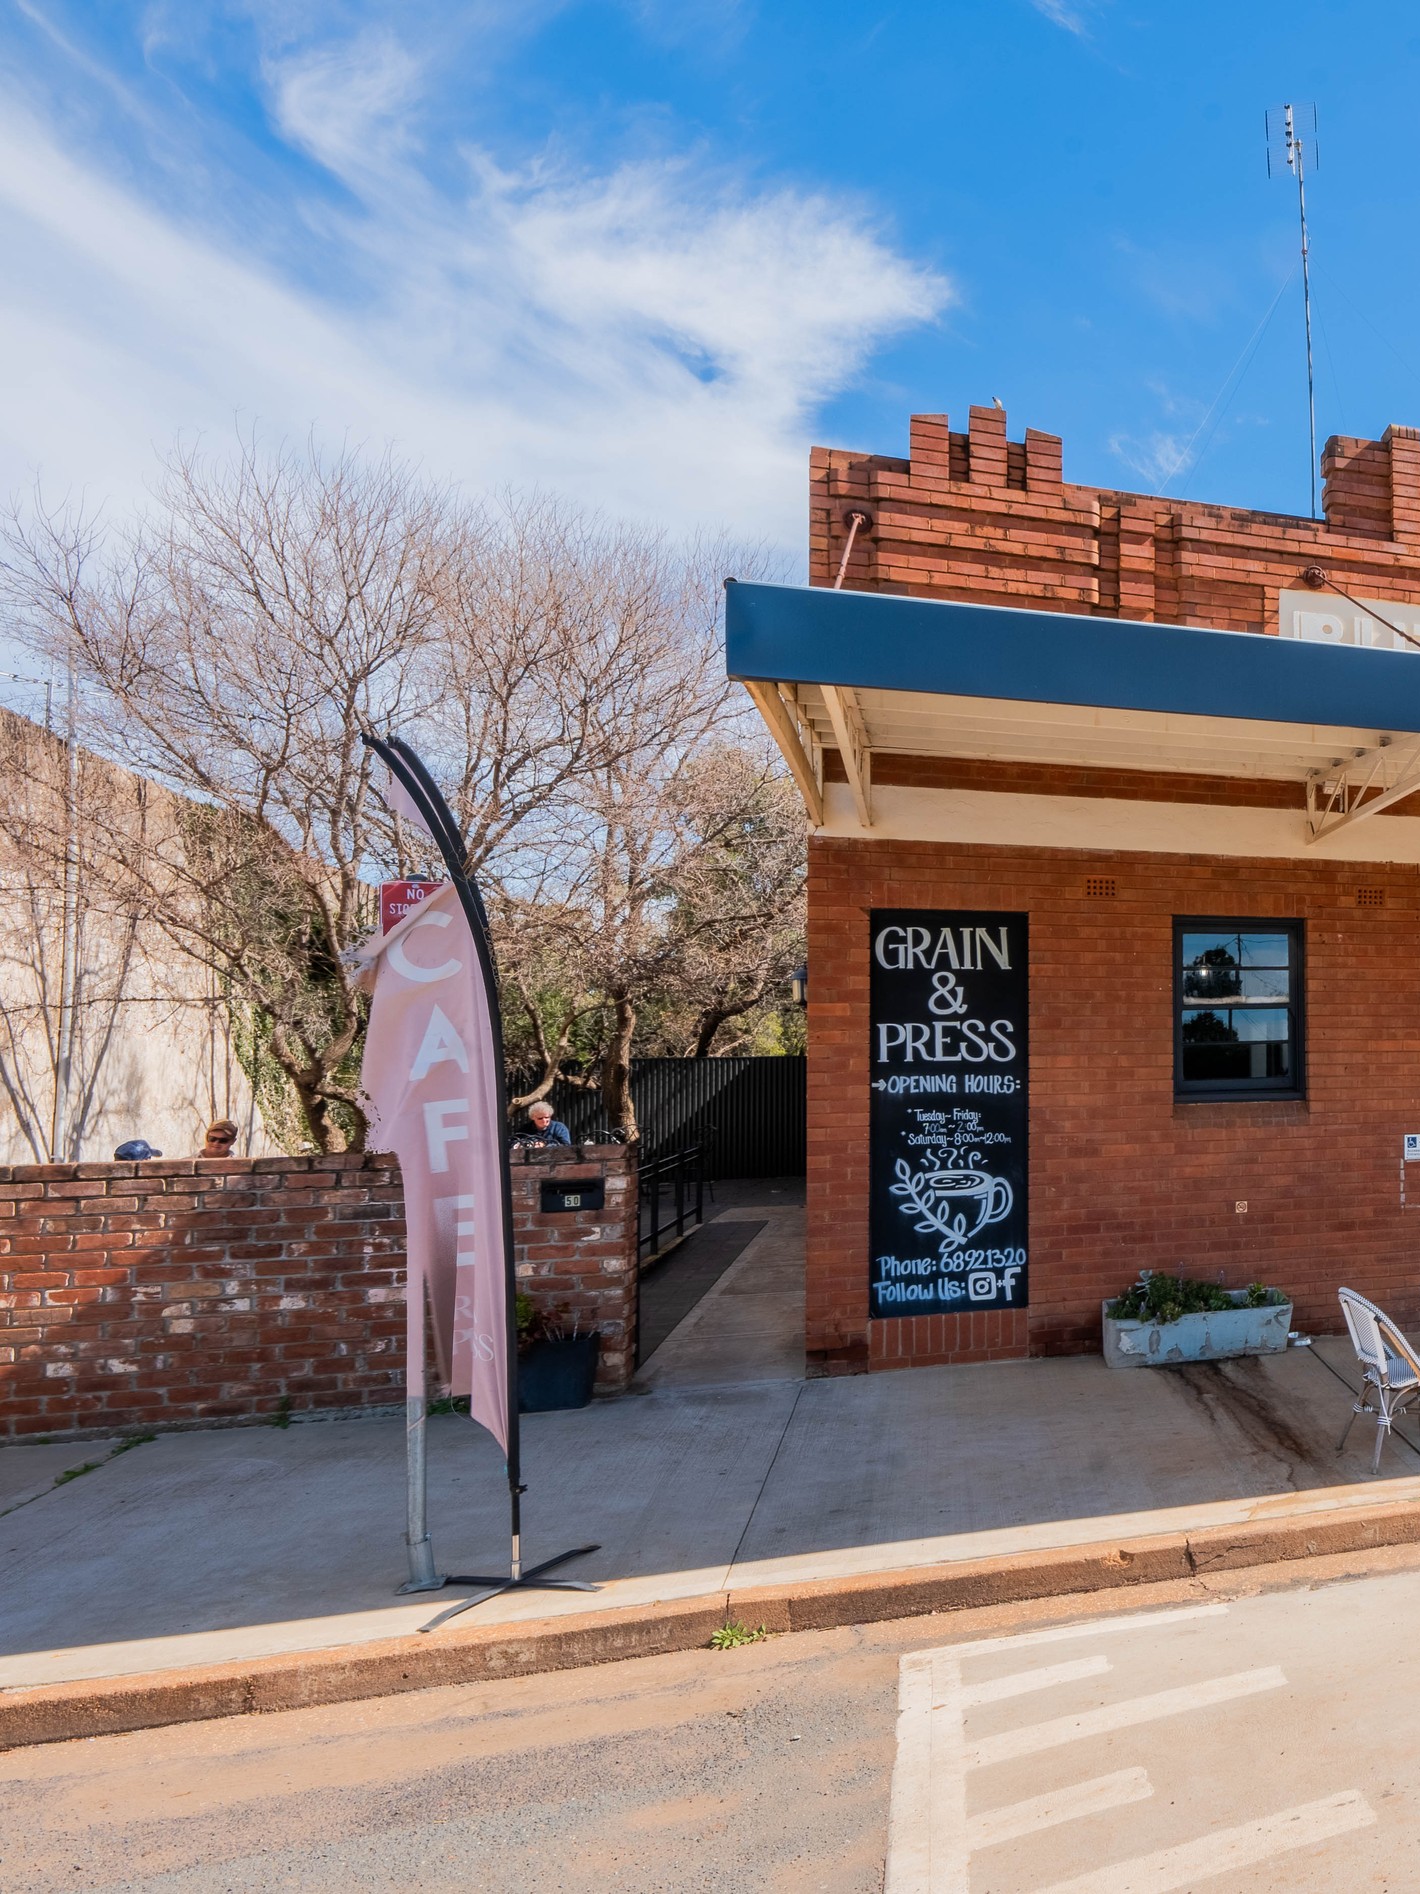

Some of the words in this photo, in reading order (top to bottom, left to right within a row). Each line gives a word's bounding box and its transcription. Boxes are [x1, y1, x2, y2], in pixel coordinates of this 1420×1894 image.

[407, 889, 425, 900] NO
[875, 926, 1012, 970] GRAIN
[928, 971, 968, 1015] &
[876, 1019, 1016, 1062] PRESS
[386, 910, 475, 1268] CAFE
[887, 1074, 957, 1094] OPENING
[964, 1074, 1021, 1094] HOURS:
[953, 1108, 981, 1123] Friday:
[566, 1196, 579, 1206] 50
[876, 1256, 937, 1280] Phone:
[940, 1248, 1027, 1273] 68921320
[872, 1281, 934, 1303] Follow
[937, 1277, 966, 1301] Us:
